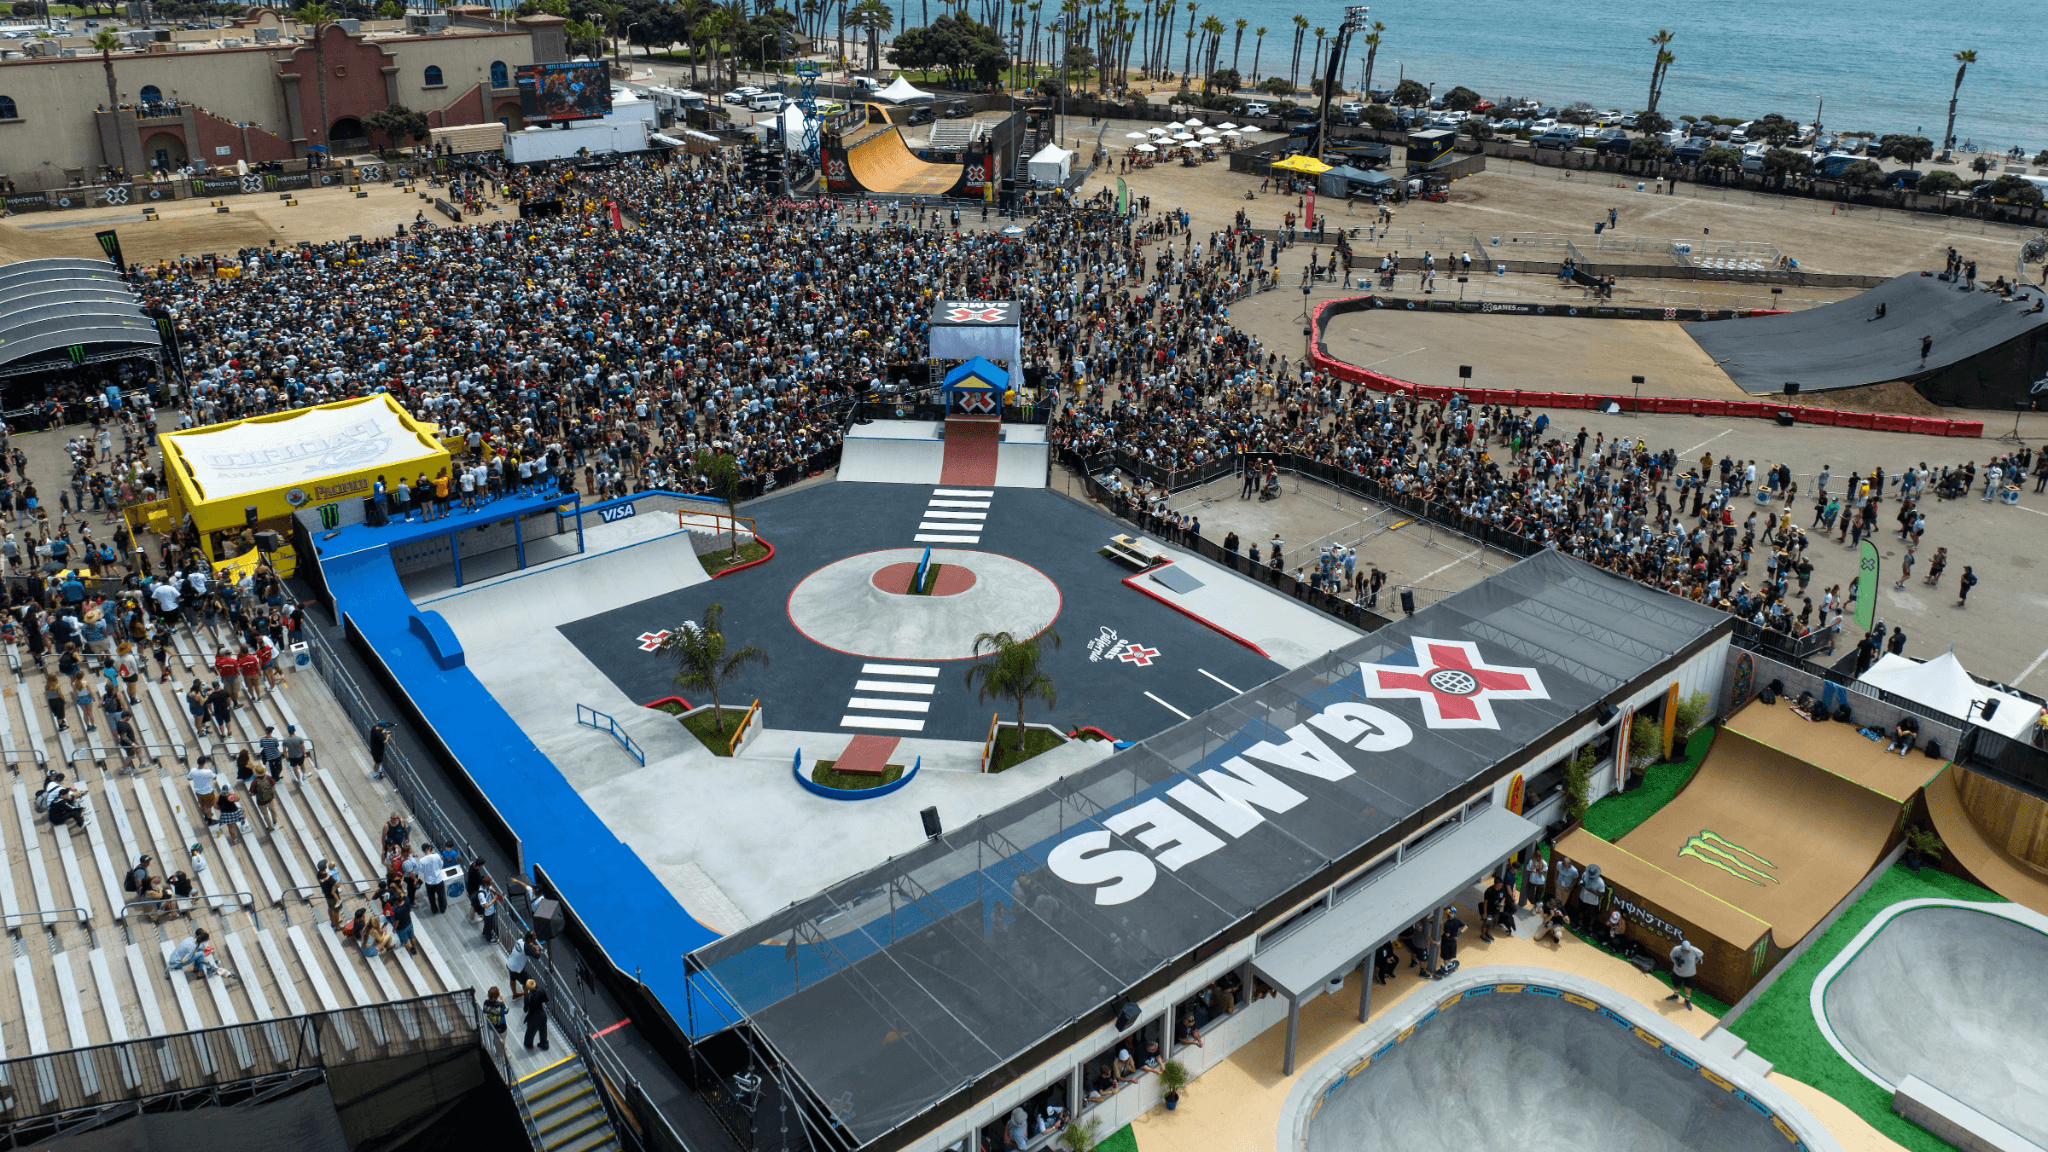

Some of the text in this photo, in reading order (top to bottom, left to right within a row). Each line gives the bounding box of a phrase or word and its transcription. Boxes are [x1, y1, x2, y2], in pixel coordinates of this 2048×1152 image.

[7, 196, 45, 204] MONSTER
[601, 504, 634, 521] VISA
[1103, 639, 1129, 660] GAMES
[1047, 701, 1414, 906] GAMES
[1613, 896, 1684, 941] MONSTER
